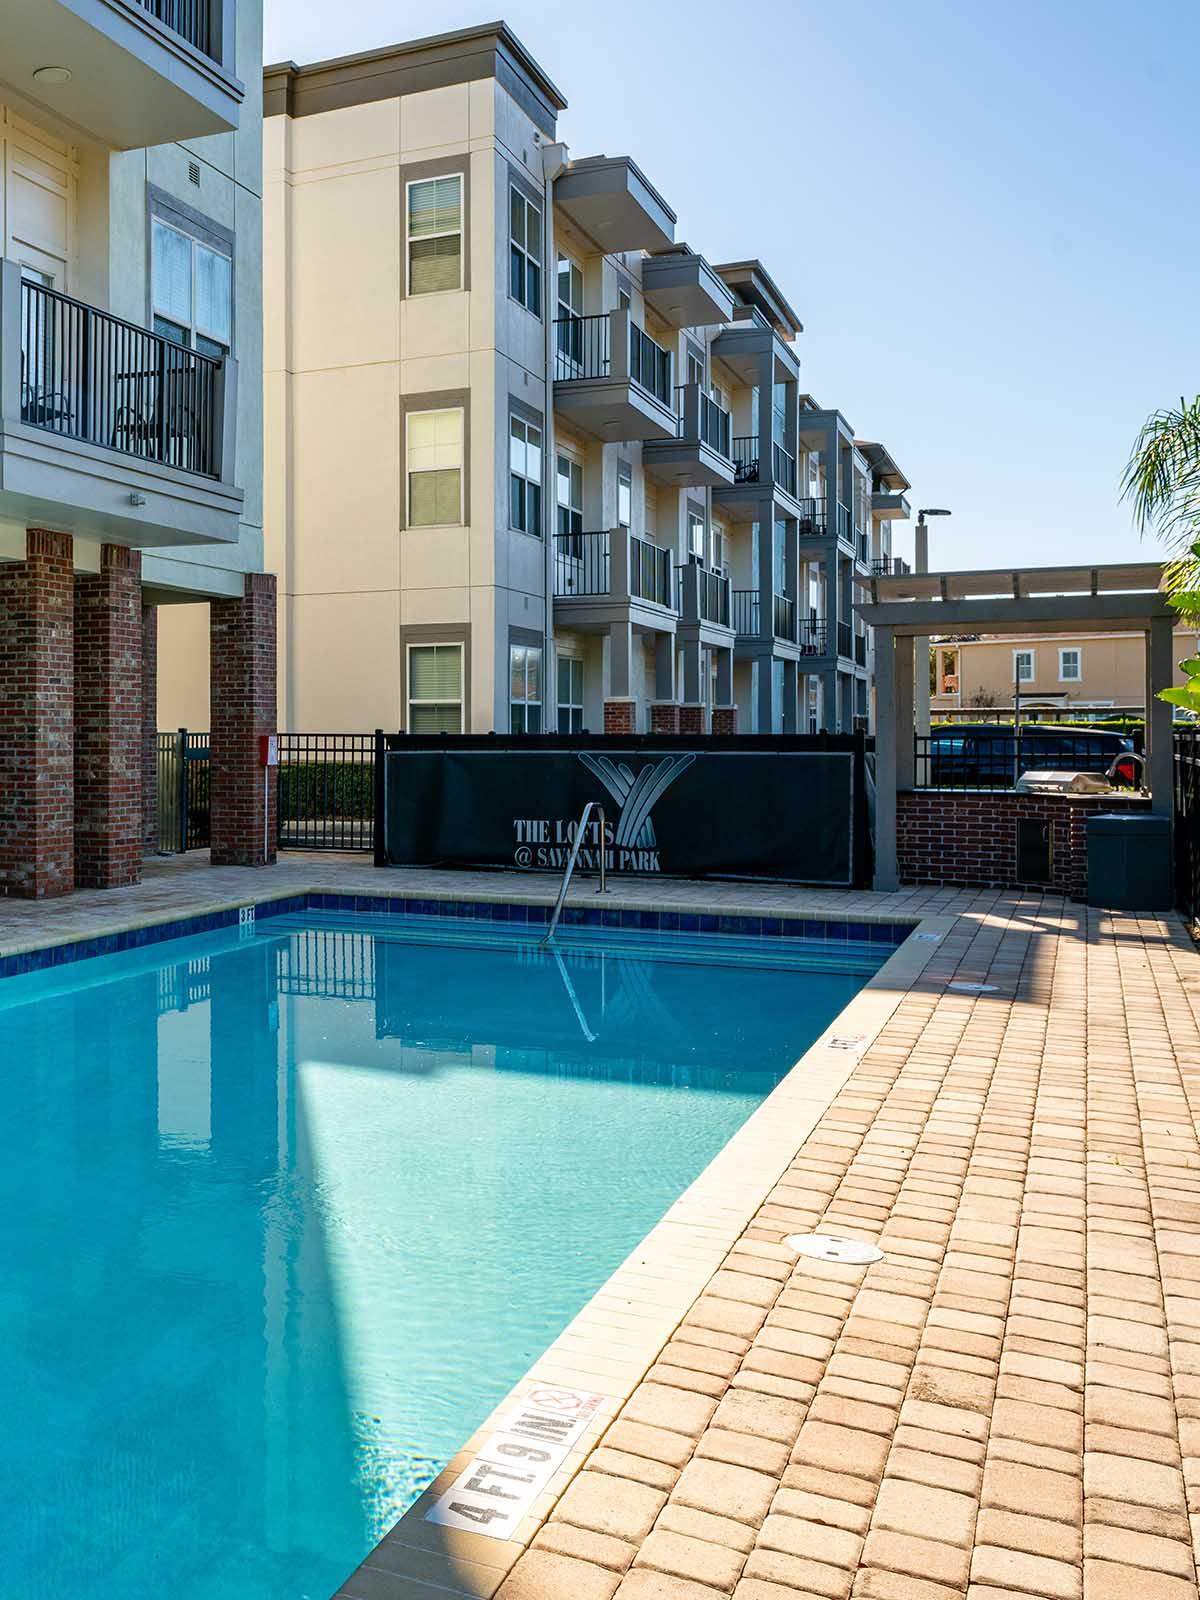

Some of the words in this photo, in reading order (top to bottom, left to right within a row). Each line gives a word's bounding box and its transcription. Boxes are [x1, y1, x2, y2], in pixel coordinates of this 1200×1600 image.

[513, 819, 550, 843] THE
[514, 846, 533, 868] @
[619, 851, 661, 871] PARK
[510, 1413, 577, 1442] IN.
[497, 1443, 551, 1462] 9
[464, 1464, 536, 1500] FT.
[448, 1502, 510, 1524] 4
